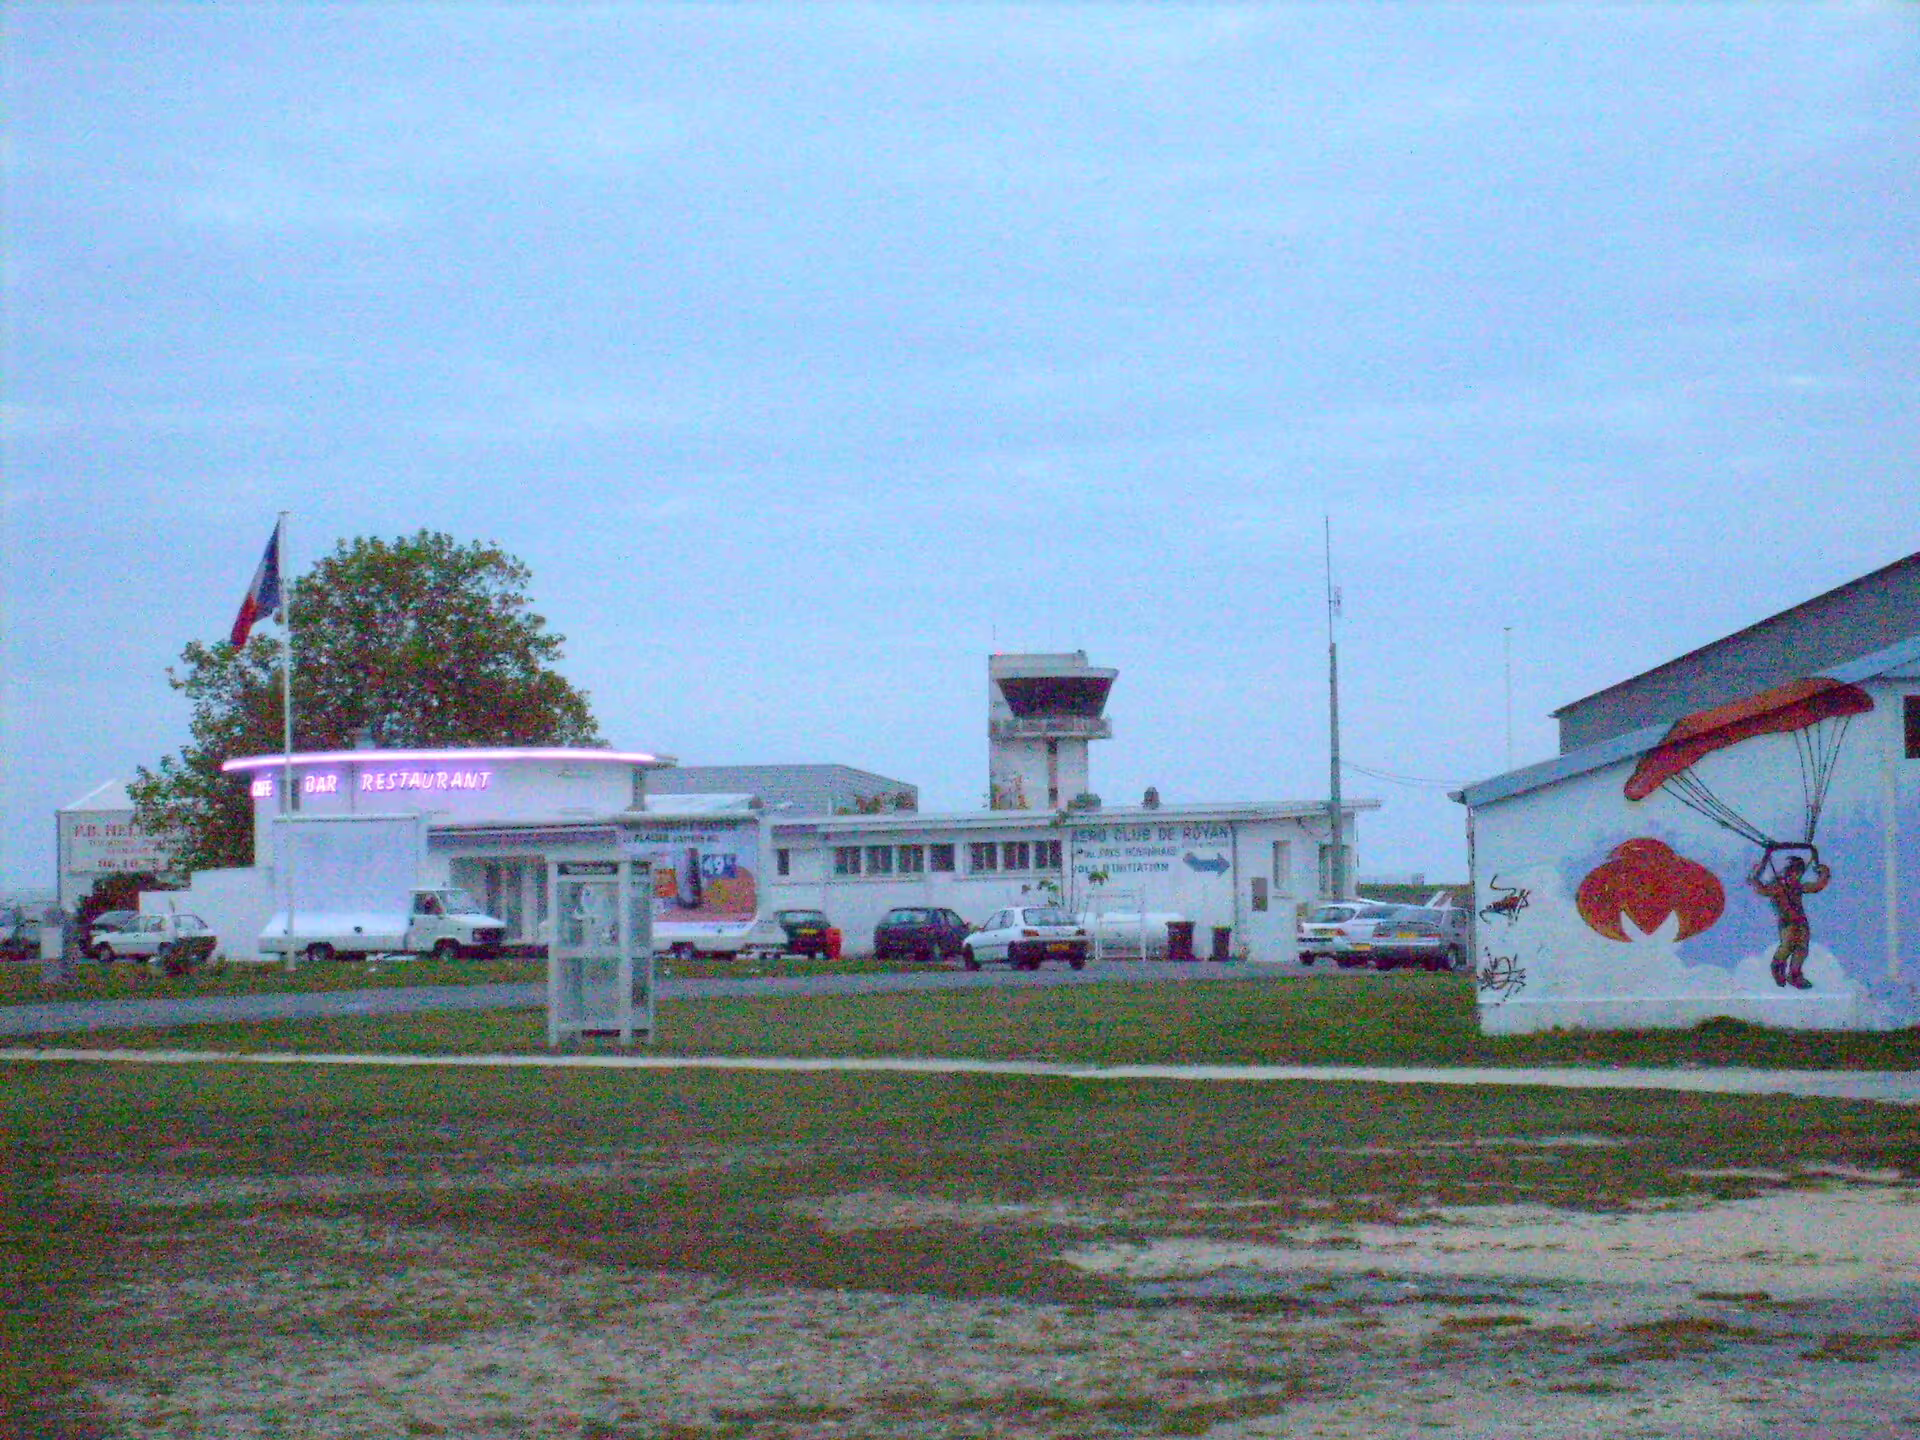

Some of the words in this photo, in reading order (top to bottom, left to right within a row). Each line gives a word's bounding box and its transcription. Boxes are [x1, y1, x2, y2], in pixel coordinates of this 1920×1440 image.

[305, 775, 337, 793] BAR
[361, 771, 493, 791] RESTAURANT
[1113, 826, 1151, 842] CLUB
[1158, 826, 1177, 842] DE
[1182, 825, 1229, 841] ROYAN
